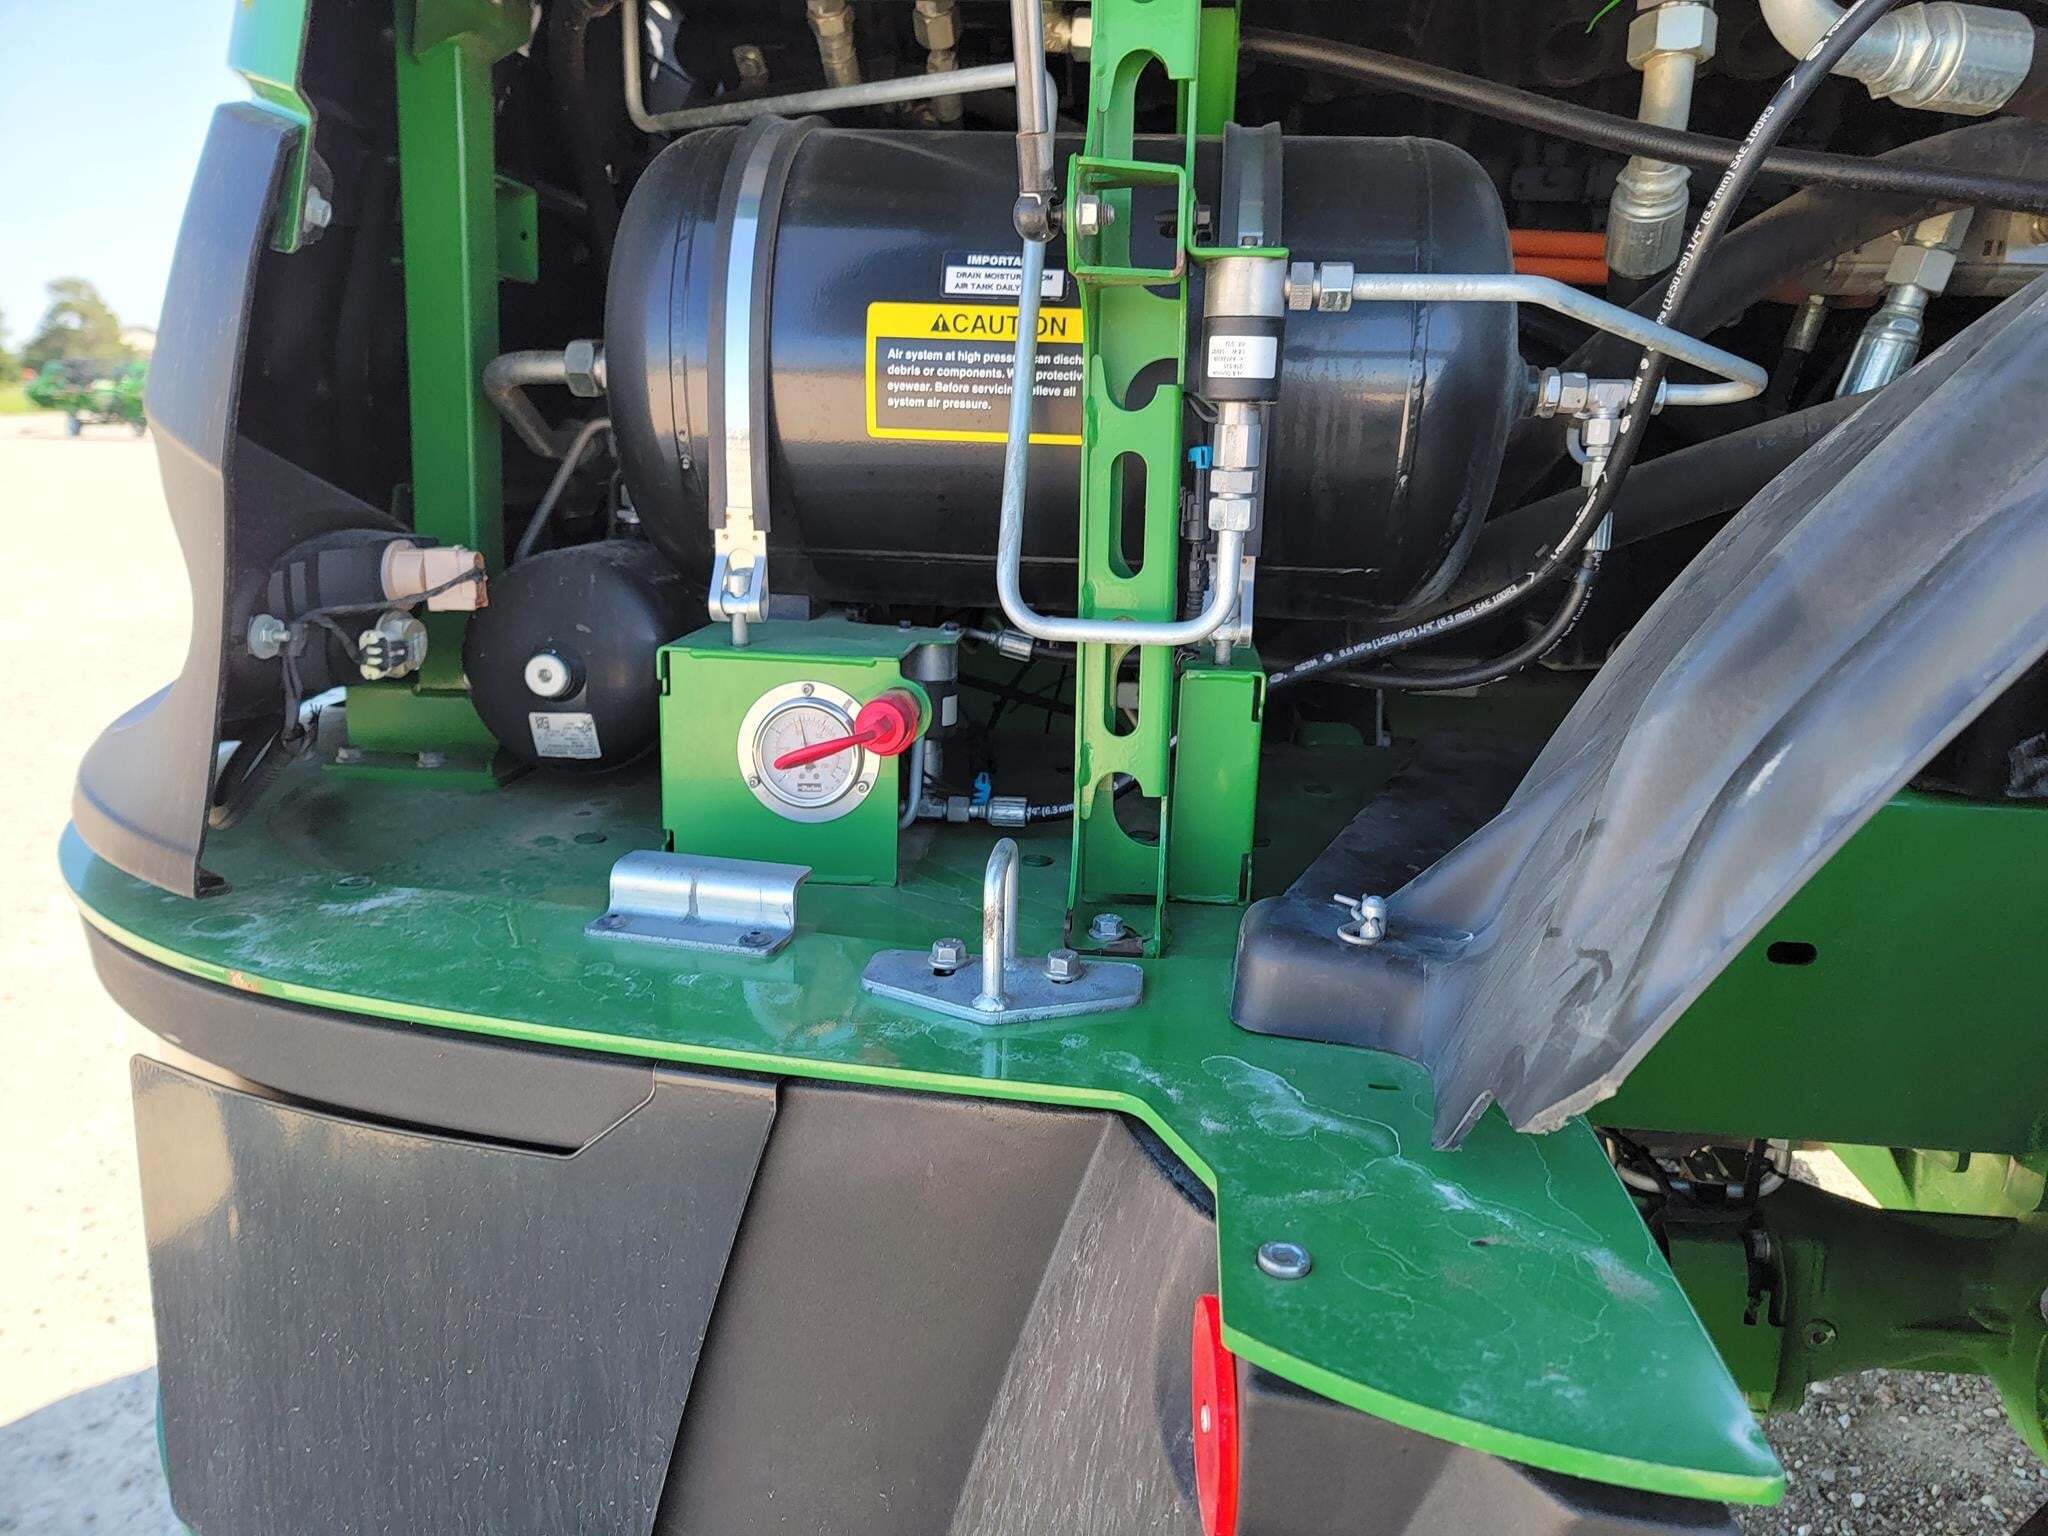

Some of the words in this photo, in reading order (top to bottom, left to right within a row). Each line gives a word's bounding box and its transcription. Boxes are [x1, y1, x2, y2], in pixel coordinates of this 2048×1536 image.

[1656, 310, 1667, 325] Pa
[1730, 145, 1750, 170] SAE
[1745, 105, 1775, 145] 100R3
[967, 254, 1024, 267] IMPORTA
[956, 271, 981, 279] DRAIN
[984, 272, 1021, 281] MOISTUR
[955, 282, 969, 290] AIR
[971, 283, 993, 291] TANK
[952, 313, 1067, 337] CAUTON
[887, 348, 903, 360] Air
[905, 349, 943, 363] system
[945, 350, 956, 362] at
[957, 350, 981, 364] high
[887, 364, 920, 376] debris
[923, 368, 935, 377] or
[936, 367, 1005, 380] components.
[1035, 370, 1084, 382] protectiv
[887, 382, 933, 393] eyewear.
[934, 381, 970, 394] Before
[971, 384, 1013, 395] servicin
[1062, 386, 1077, 397] all
[887, 397, 925, 409] system
[926, 397, 941, 409] air
[942, 399, 992, 411] pressure.
[1475, 597, 1494, 613] SAE
[1493, 584, 1518, 606] 100R3
